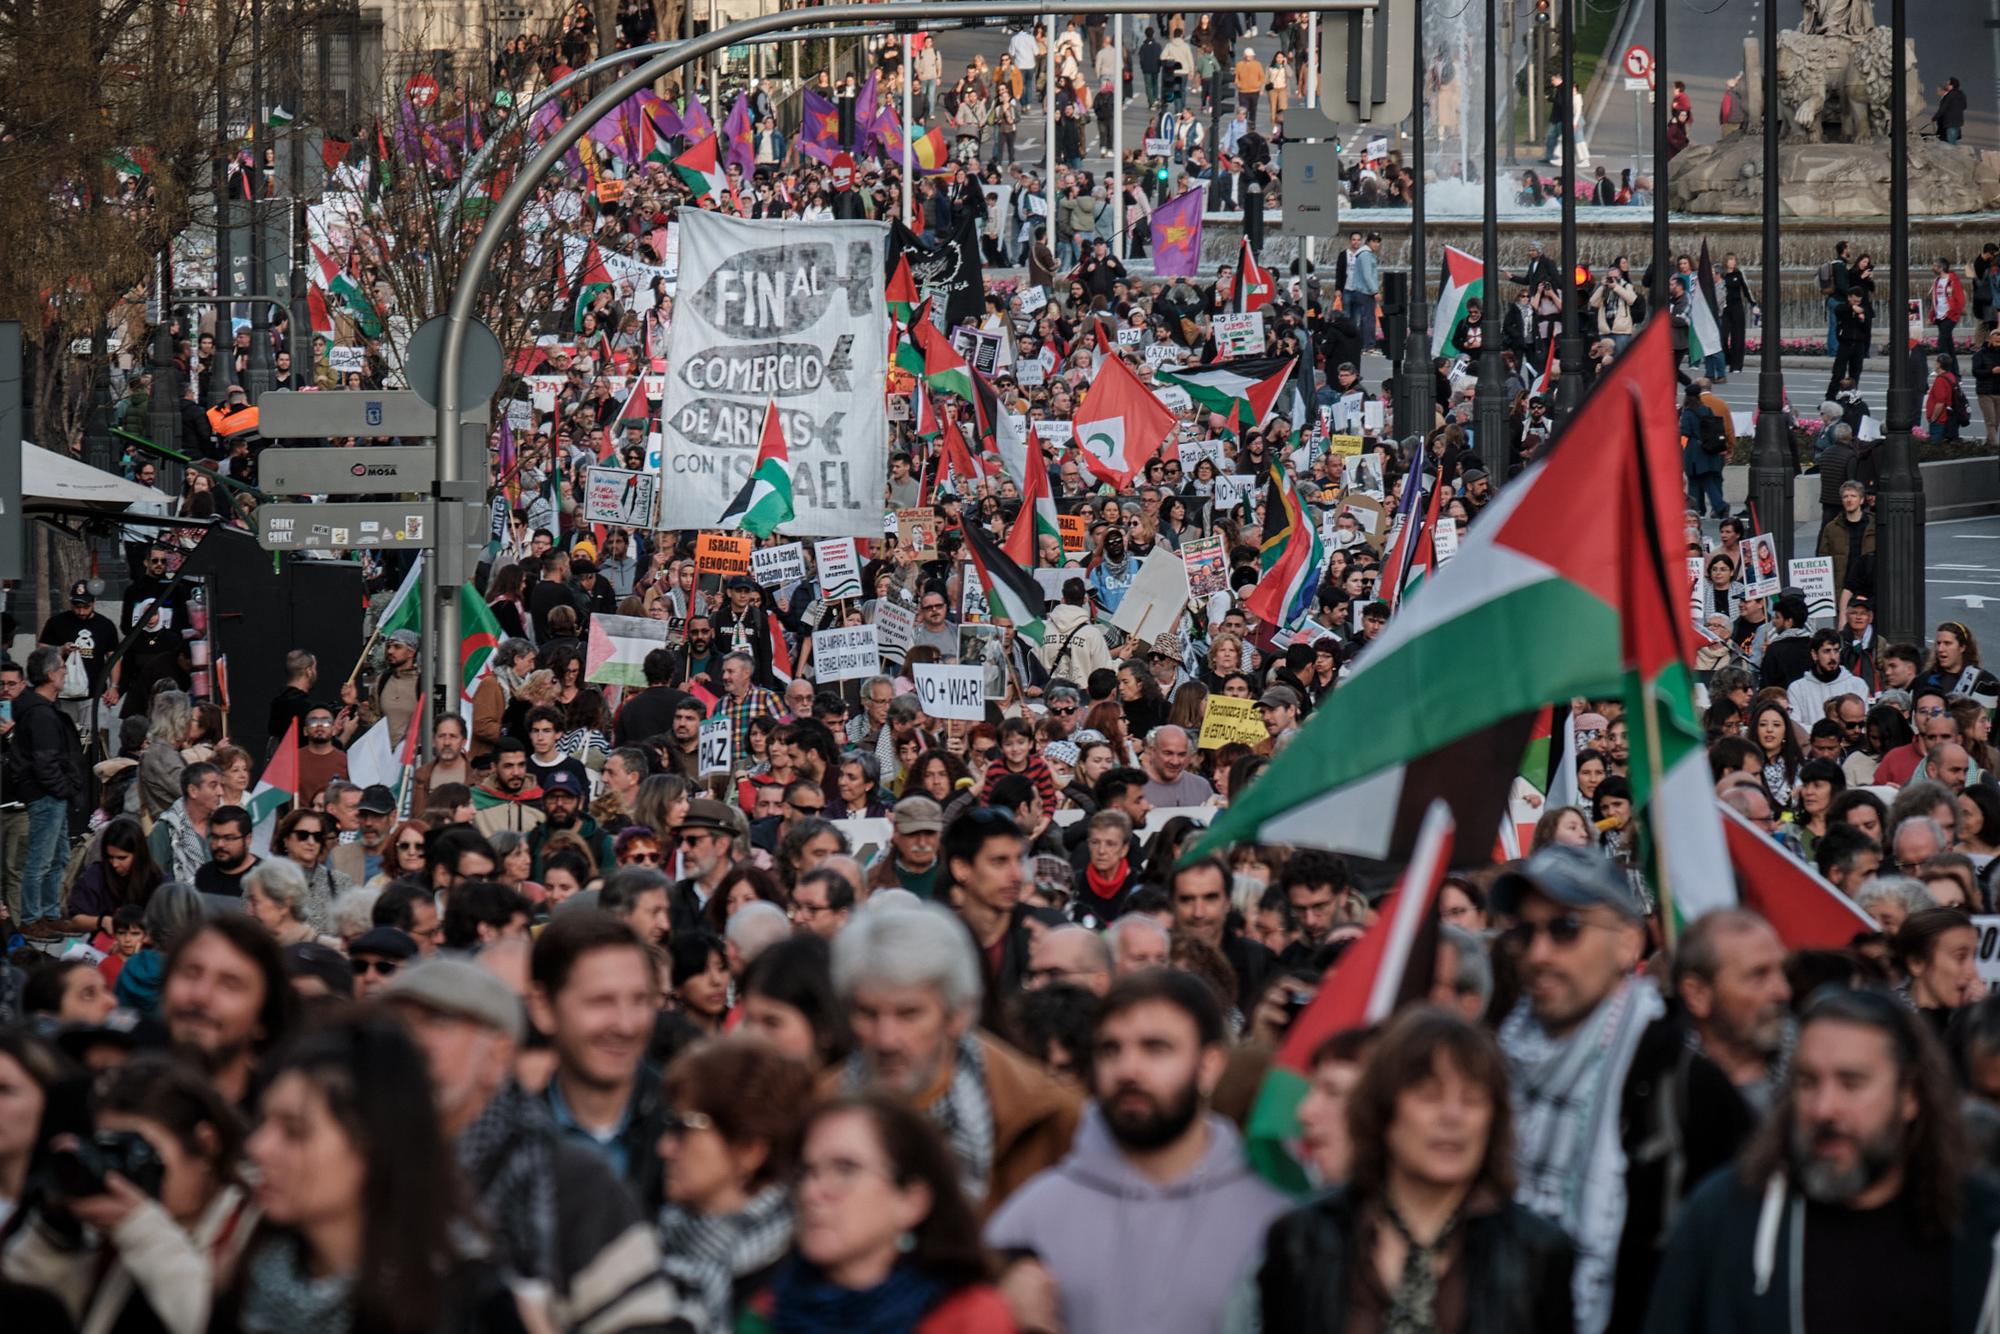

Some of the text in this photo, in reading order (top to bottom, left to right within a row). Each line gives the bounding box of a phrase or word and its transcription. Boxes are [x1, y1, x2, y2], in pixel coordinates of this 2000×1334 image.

[714, 266, 824, 328] FIN AL
[1120, 331, 1139, 344] PAZ
[686, 355, 824, 393] COMERCIO
[681, 408, 710, 435] DE
[368, 468, 397, 476] MOSA
[672, 453, 861, 510] CON ISAEL
[1216, 484, 1227, 501] NO
[700, 556, 748, 573] GENOCIDA!
[773, 551, 778, 564] e
[1793, 560, 1828, 569] MURCIA
[756, 568, 783, 583] racismo
[1793, 568, 1830, 577] PALESTINA
[878, 607, 911, 624] PALESTINA
[816, 636, 827, 651] USA
[823, 656, 838, 672] ISRAEL
[839, 654, 857, 670] ARRASA
[916, 677, 935, 704] NO
[948, 678, 982, 706] WAR!
[701, 719, 728, 736] JUSTA
[1209, 724, 1237, 740] ESTADO
[701, 737, 727, 771] PAZ
